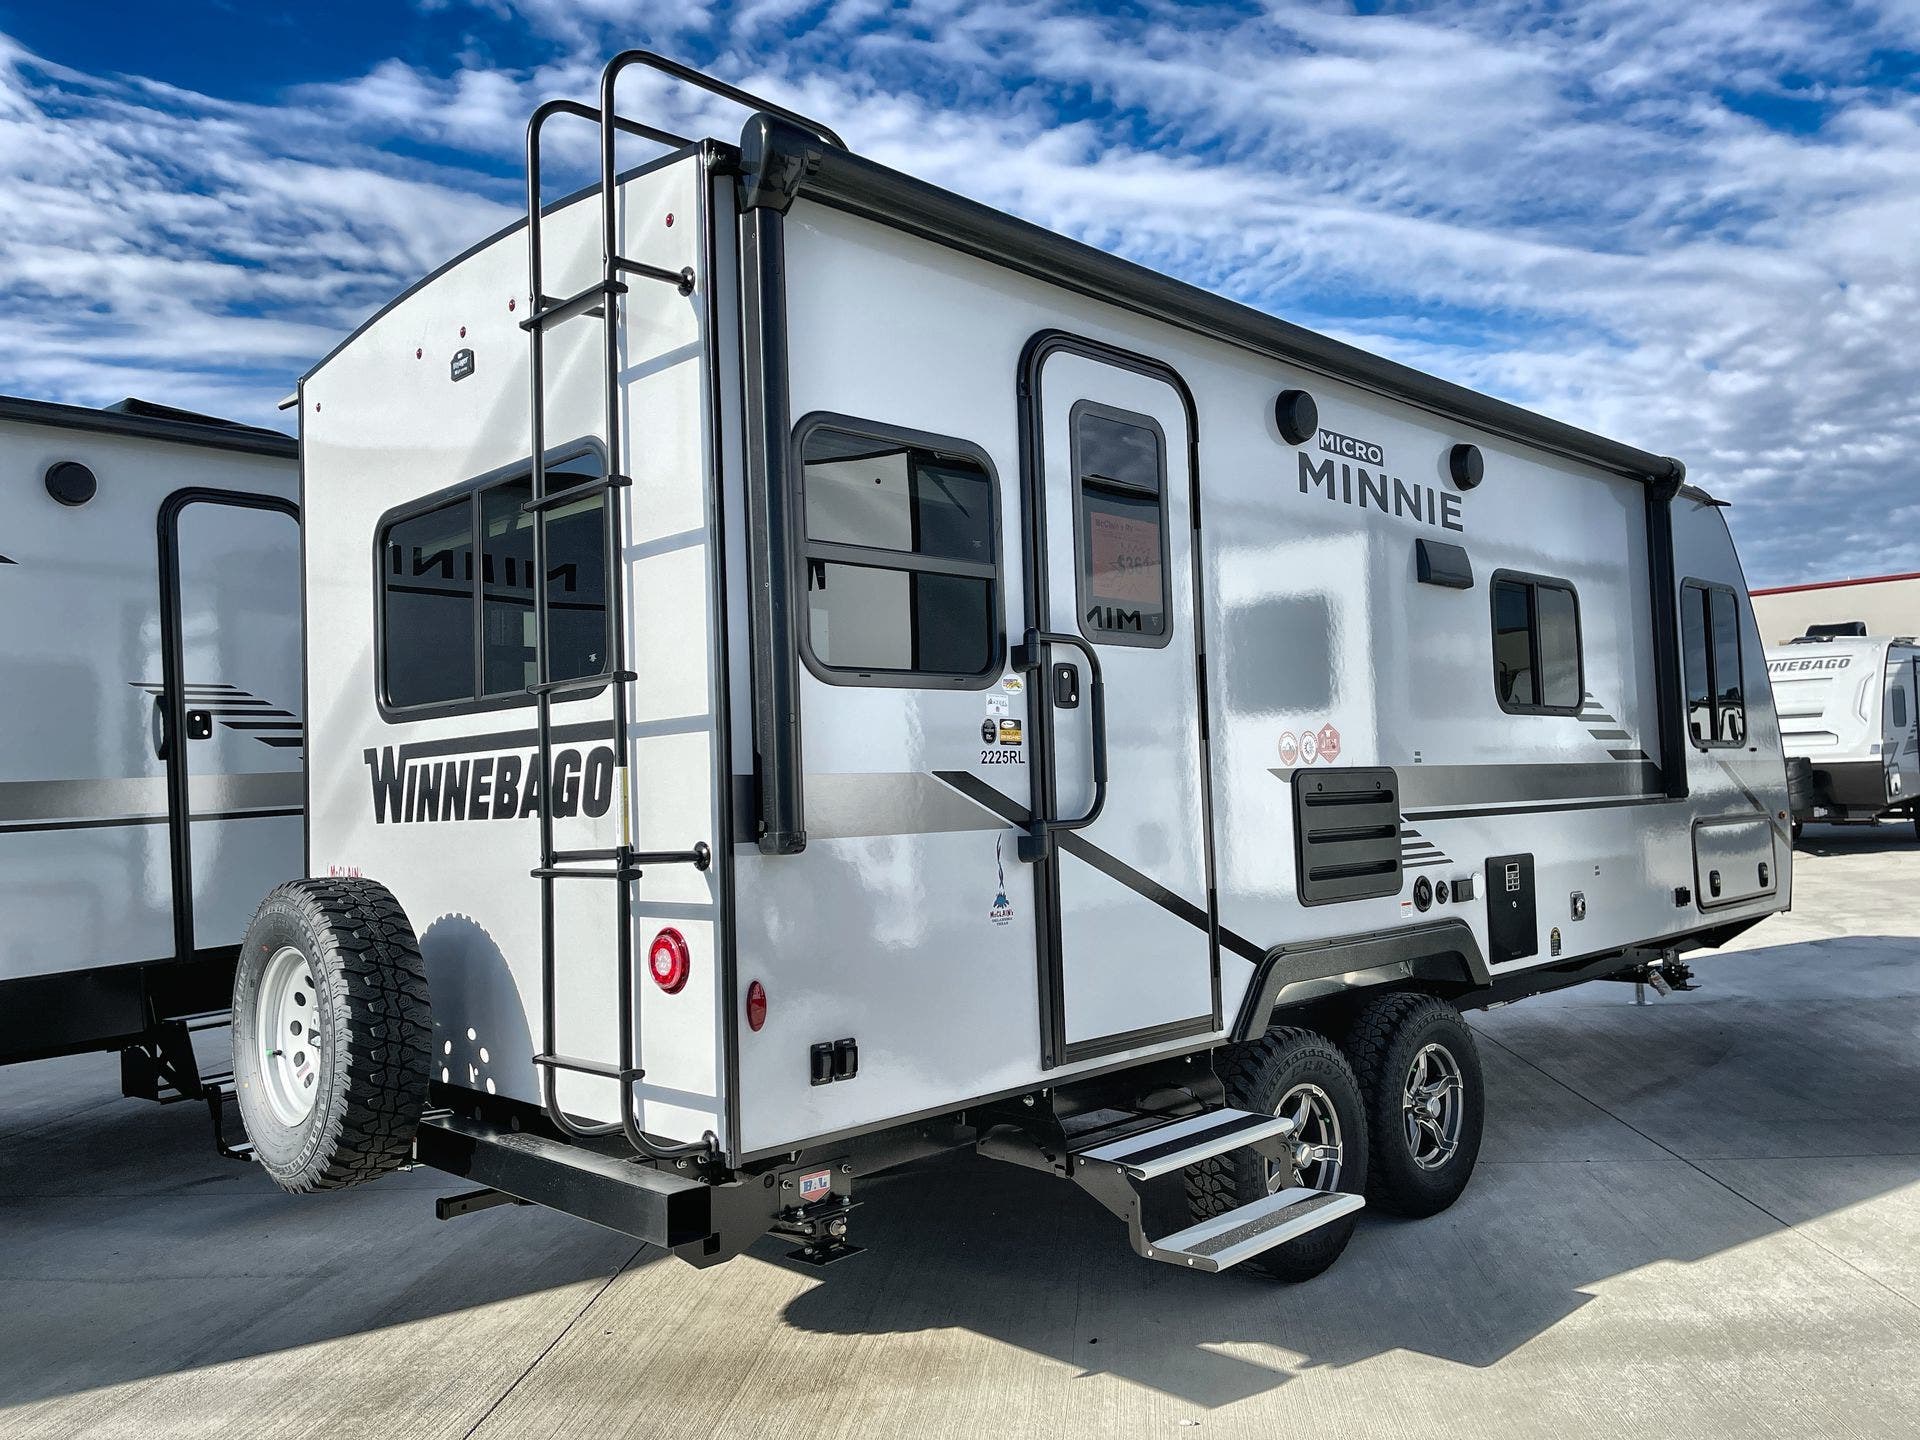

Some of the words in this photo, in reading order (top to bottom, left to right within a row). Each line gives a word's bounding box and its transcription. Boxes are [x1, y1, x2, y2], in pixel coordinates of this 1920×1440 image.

[1320, 431, 1382, 463] MICRO
[1298, 451, 1464, 532] MINNIE
[363, 745, 615, 824] WINNEBAGO
[980, 751, 1025, 764] 2225RL
